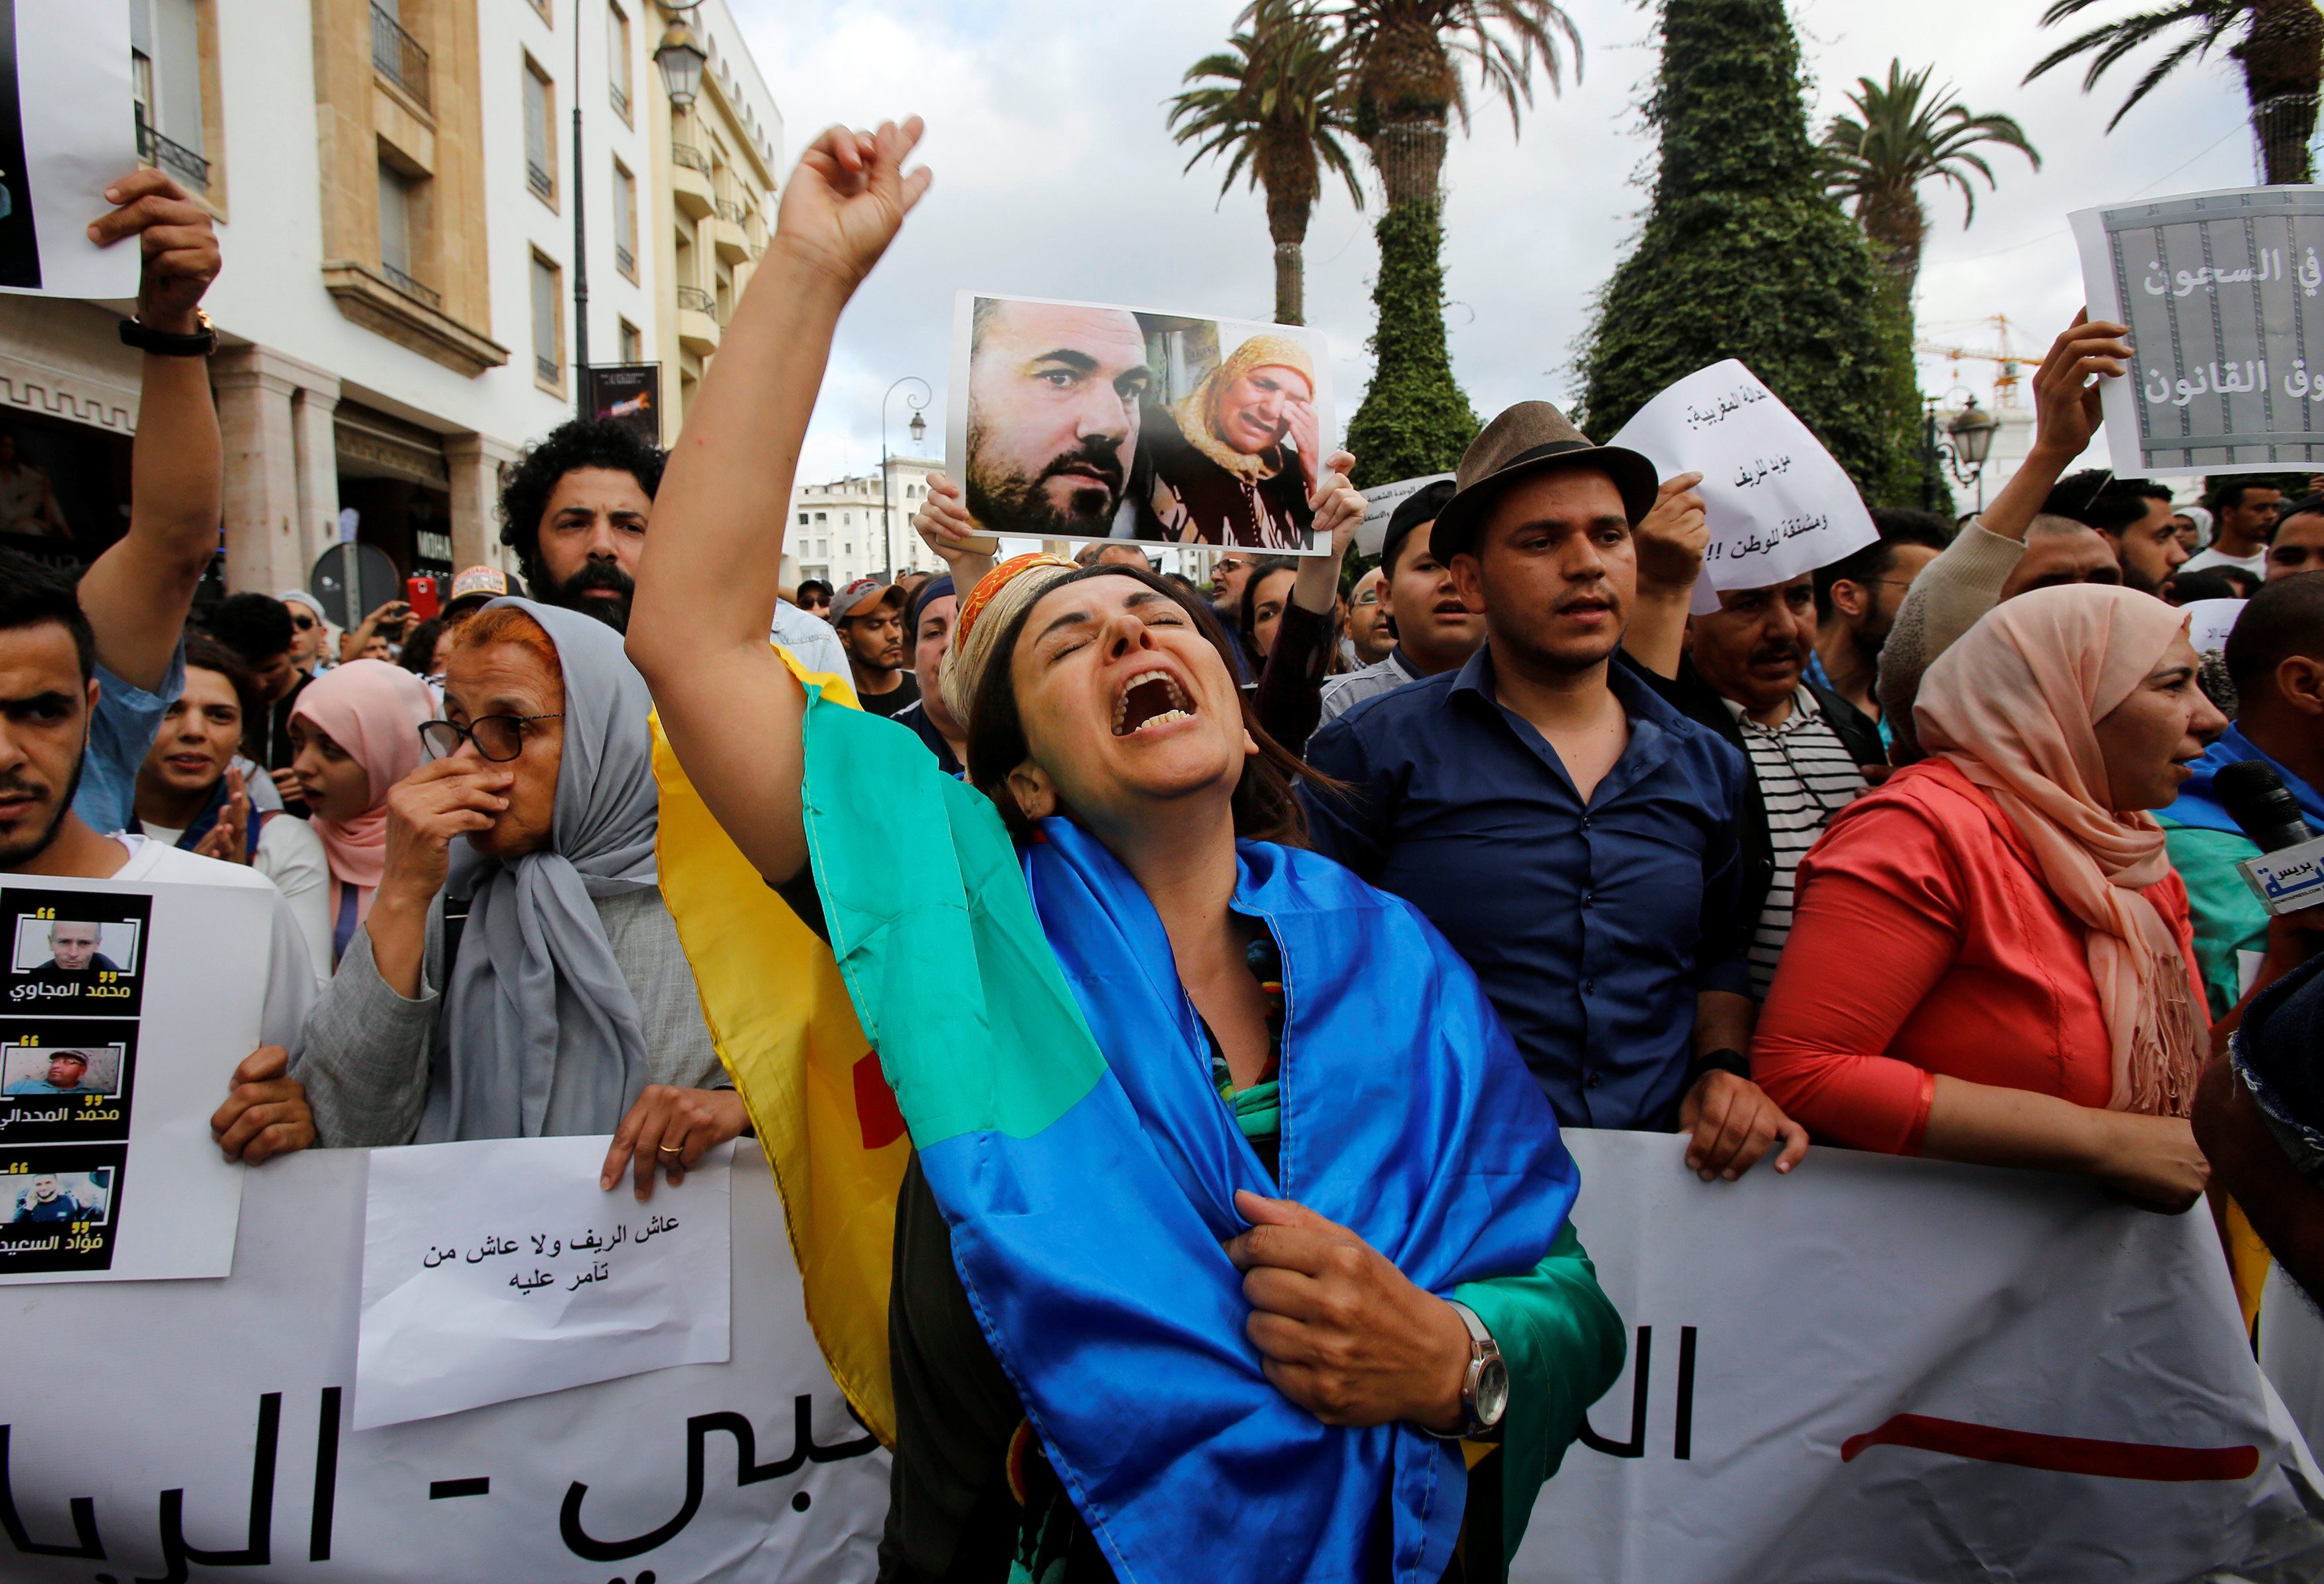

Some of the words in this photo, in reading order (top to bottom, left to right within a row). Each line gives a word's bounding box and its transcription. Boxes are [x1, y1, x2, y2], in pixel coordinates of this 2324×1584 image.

[2143, 248, 2282, 296] السجون
[2298, 247, 2321, 297] في
[2145, 361, 2269, 406] القانون
[1730, 528, 1780, 559] للوطن
[9, 982, 80, 1002] المجاوي
[86, 986, 130, 998] محمد
[74, 1109, 120, 1121] محمد
[64, 1233, 104, 1254] فؤاد
[570, 1224, 627, 1252] الريف
[634, 1215, 680, 1244] عاش
[423, 1245, 456, 1269] من
[466, 1237, 519, 1265] عاش
[531, 1234, 561, 1257] ولا
[509, 1269, 554, 1296] عليه
[565, 1260, 609, 1291] تآمر
